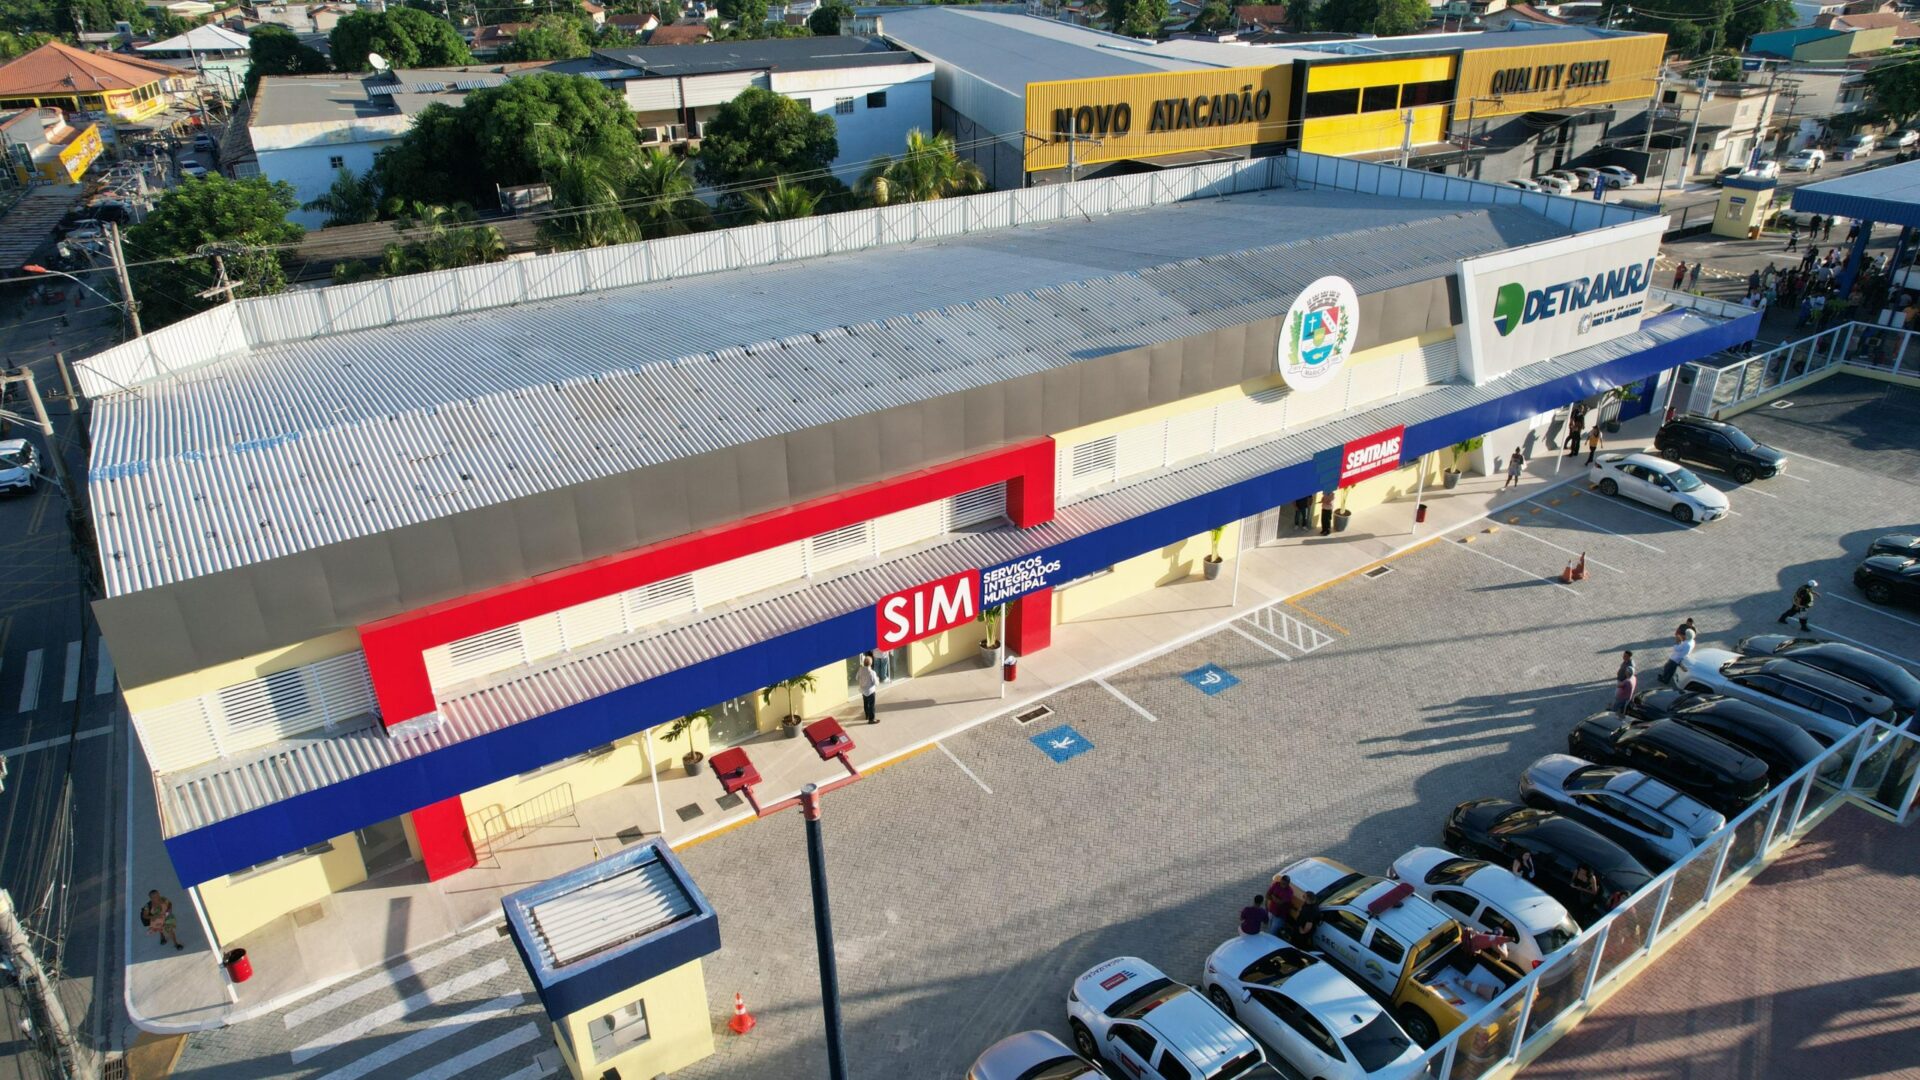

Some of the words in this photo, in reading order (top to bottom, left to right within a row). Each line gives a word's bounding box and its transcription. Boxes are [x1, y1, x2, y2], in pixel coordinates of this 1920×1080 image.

[1491, 64, 1565, 95] QUALITY
[1566, 60, 1610, 89] STEEL
[1053, 103, 1131, 143] NOVO
[1149, 85, 1272, 134] ATACADÃO
[1346, 436, 1401, 470] SEMTRANS
[983, 555, 1043, 584] SERVIÇOS
[984, 559, 1061, 595] INTEGRADOS
[983, 575, 1047, 606] MUNICIPAL
[883, 576, 974, 643] SIM
